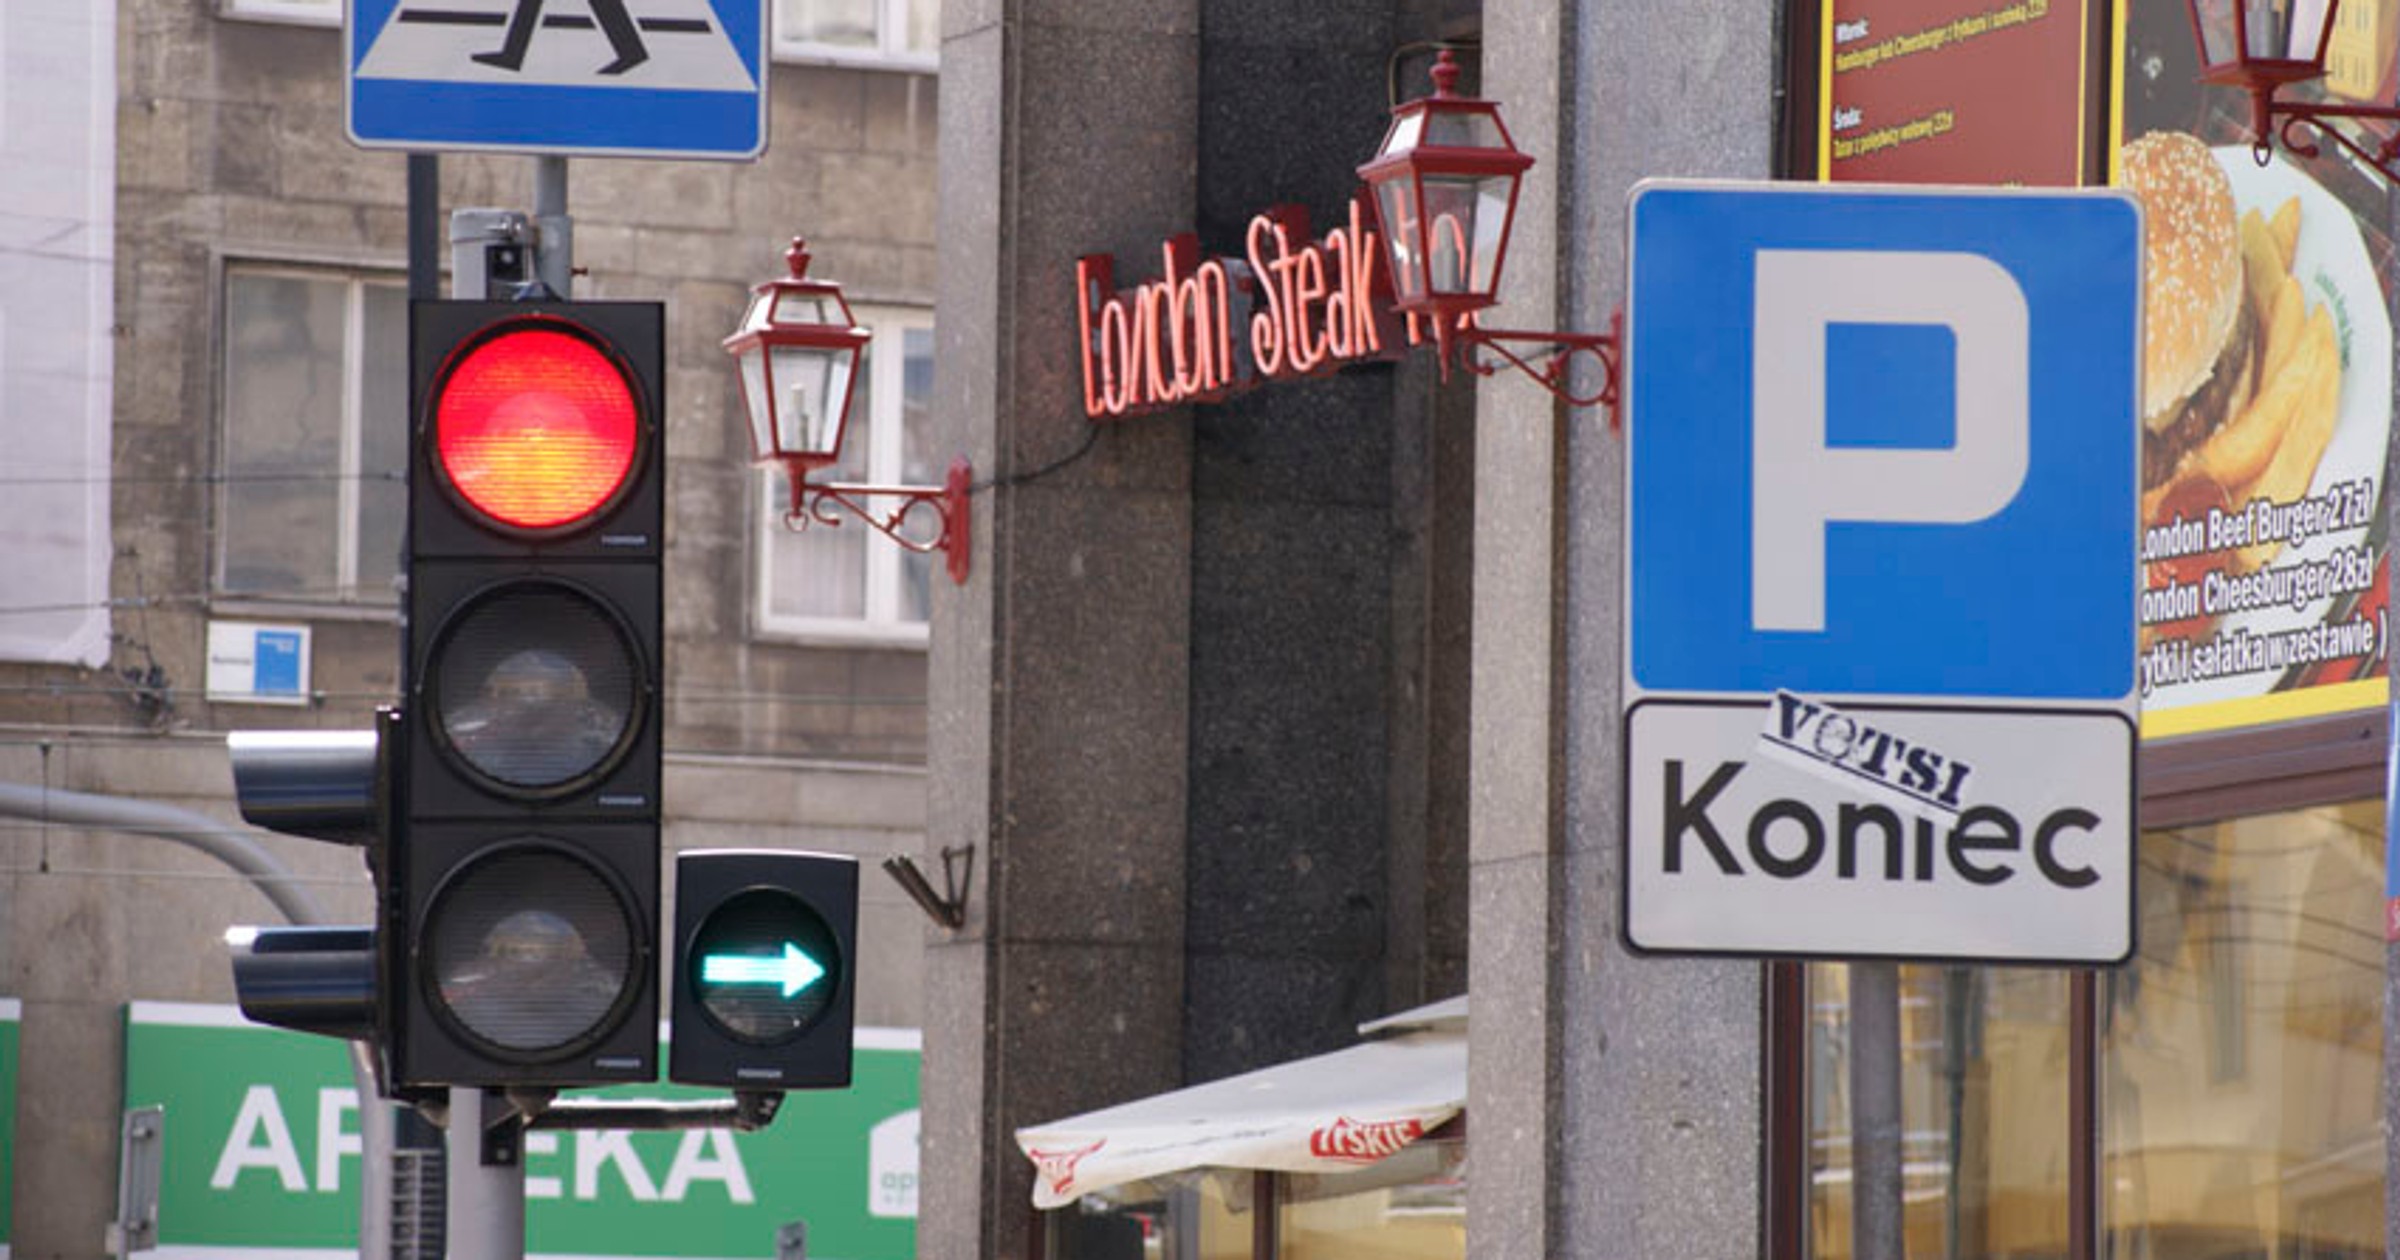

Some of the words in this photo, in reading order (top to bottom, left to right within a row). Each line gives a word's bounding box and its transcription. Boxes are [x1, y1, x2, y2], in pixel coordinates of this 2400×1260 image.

[1076, 239, 1231, 417] London
[1247, 199, 1382, 375] Steak
[1752, 249, 2030, 631] P
[2142, 515, 2205, 560] ondon
[2208, 501, 2255, 549] Beef
[2257, 496, 2328, 546] Burger
[2328, 479, 2373, 530] 27zł
[2142, 577, 2199, 623] ondon
[2204, 562, 2328, 612] Cheesburger
[2330, 545, 2373, 595] 28zł
[2142, 640, 2178, 693] ytki
[2193, 627, 2264, 677] sałatka
[2289, 612, 2373, 663] zestawie
[1777, 692, 1971, 806] VOTSI
[1663, 759, 2101, 888] Koniec
[210, 1085, 755, 1204] APKA
